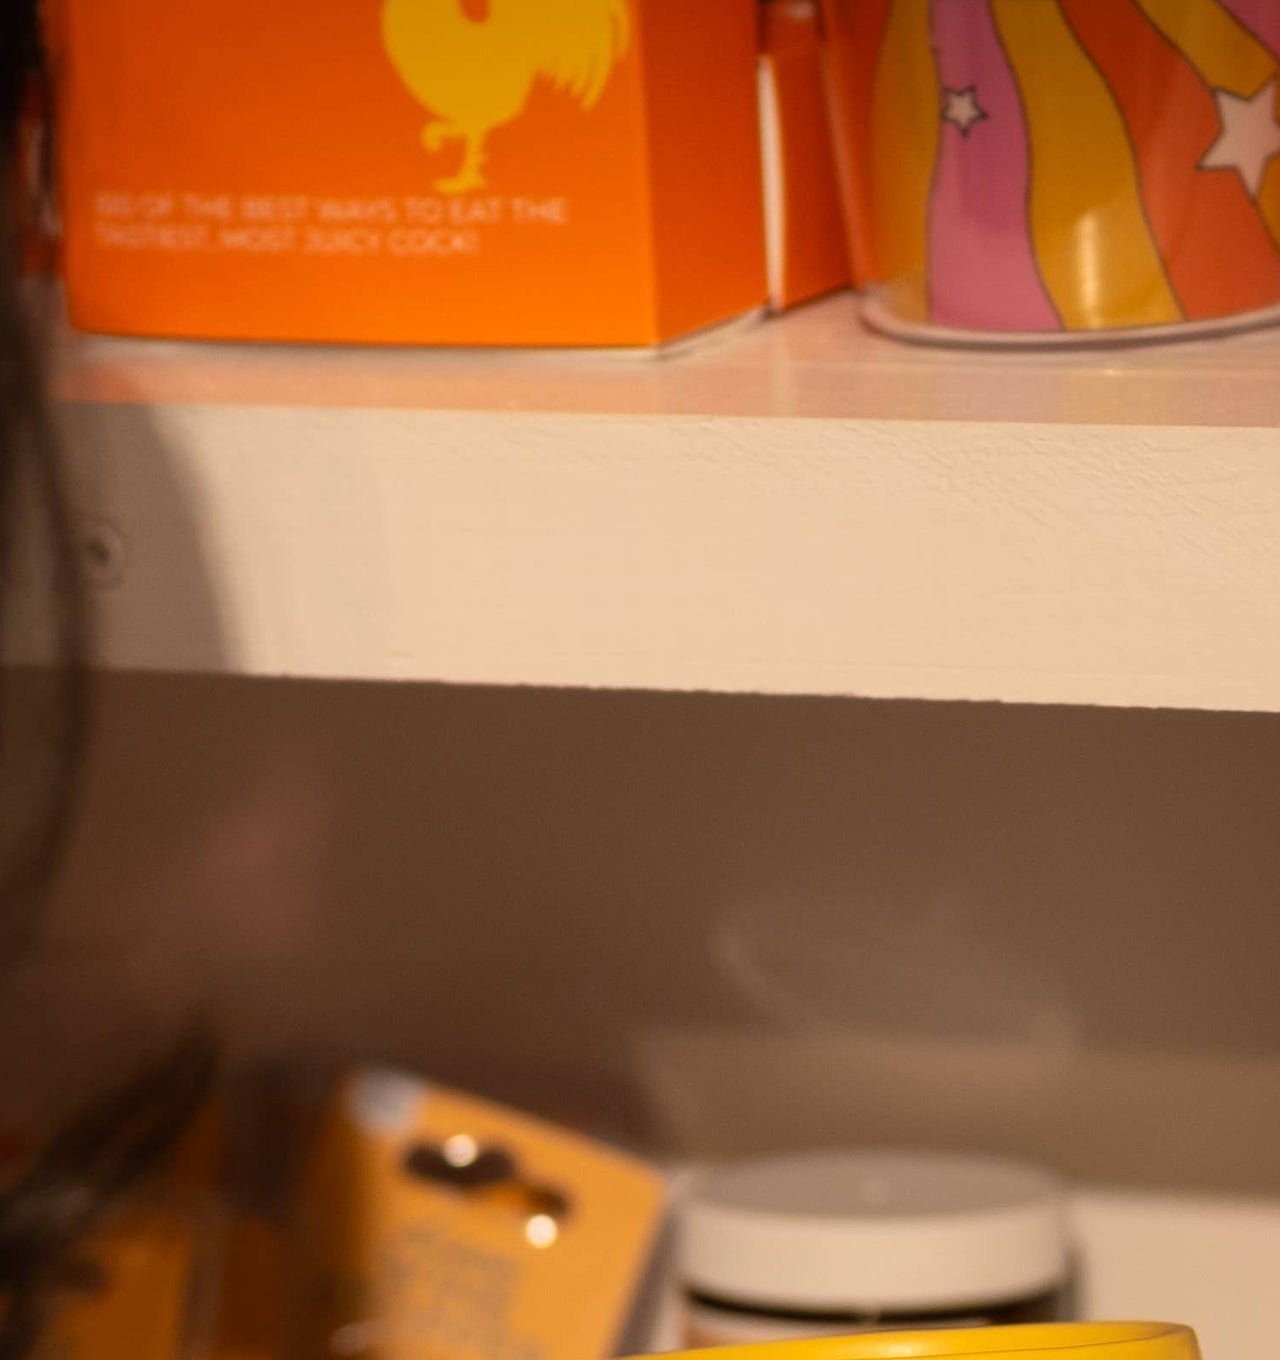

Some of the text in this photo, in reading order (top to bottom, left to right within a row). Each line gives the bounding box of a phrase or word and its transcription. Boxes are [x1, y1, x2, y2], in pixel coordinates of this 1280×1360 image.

[403, 194, 445, 223] TO
[449, 195, 503, 224] EAT
[511, 195, 569, 225] THE
